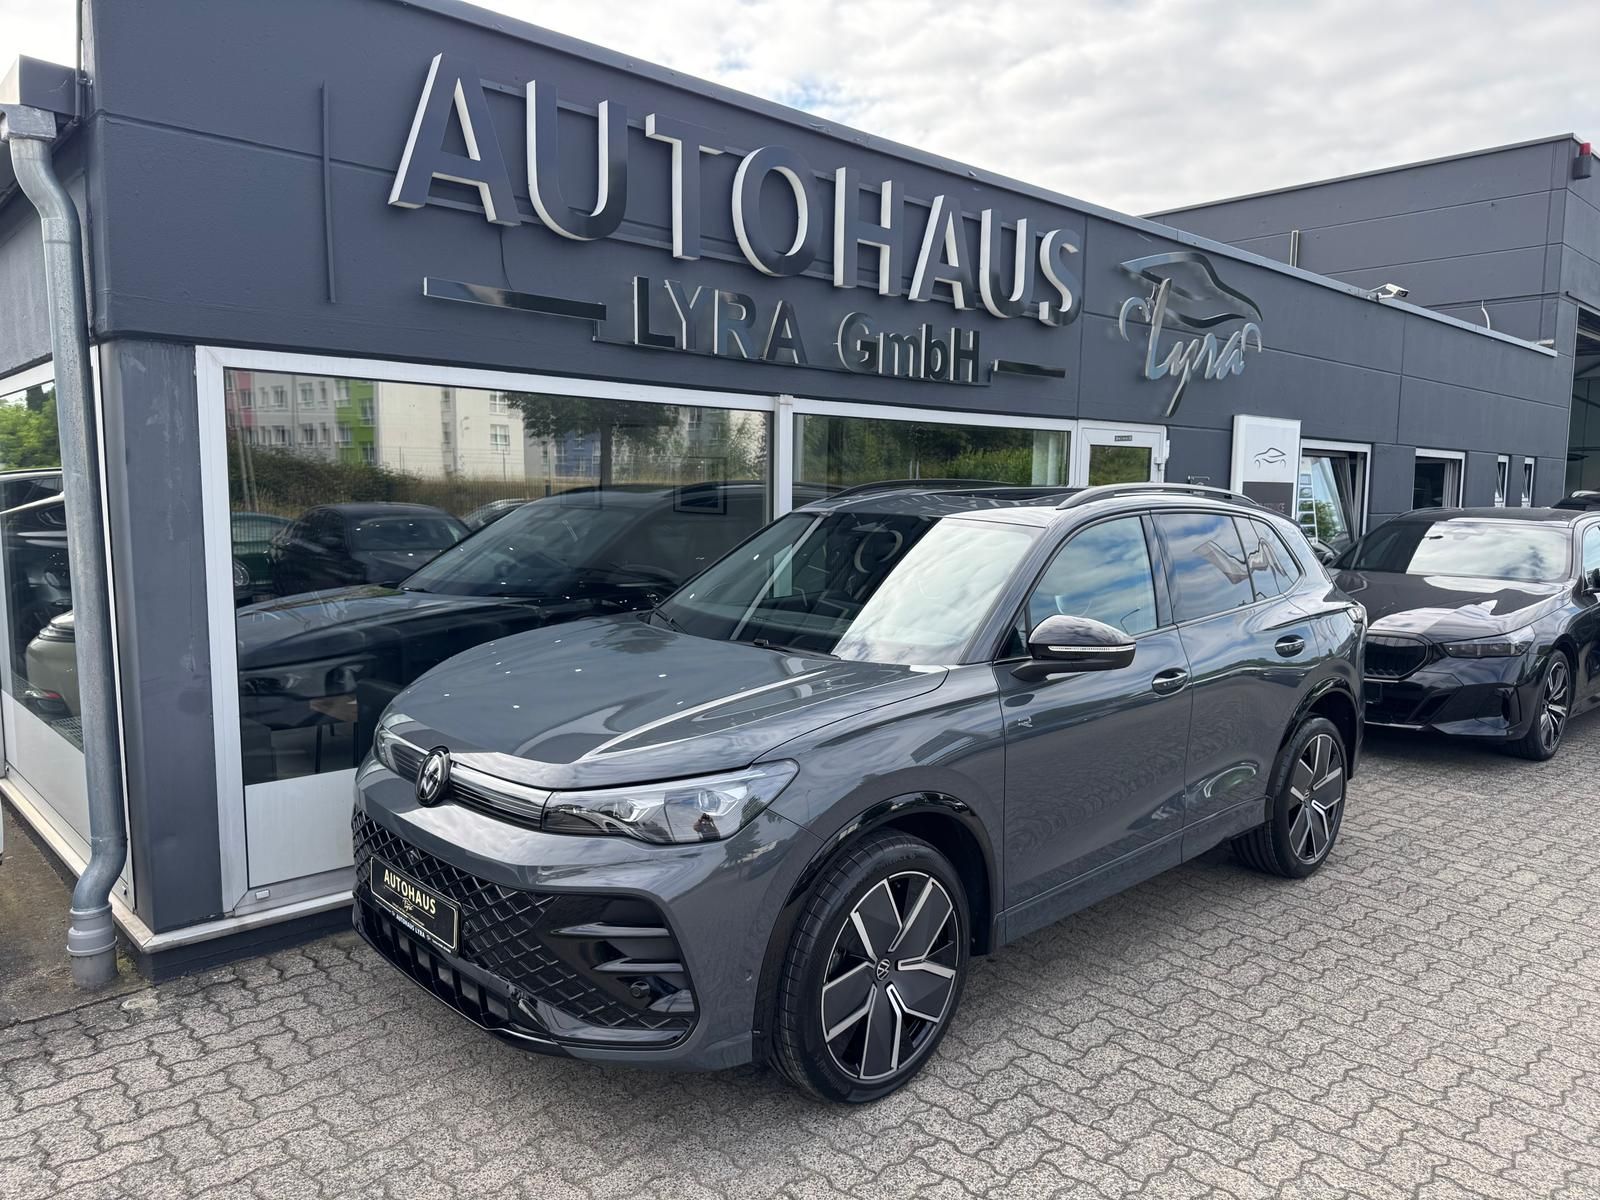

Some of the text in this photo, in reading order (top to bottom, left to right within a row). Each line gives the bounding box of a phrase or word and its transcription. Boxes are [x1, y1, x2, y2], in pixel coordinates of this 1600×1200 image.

[387, 52, 1082, 328] AUTOHAUS
[632, 275, 981, 383] LYRA GmbH
[1144, 278, 1247, 418] Lyra
[383, 868, 436, 915] AUTOHAUS
